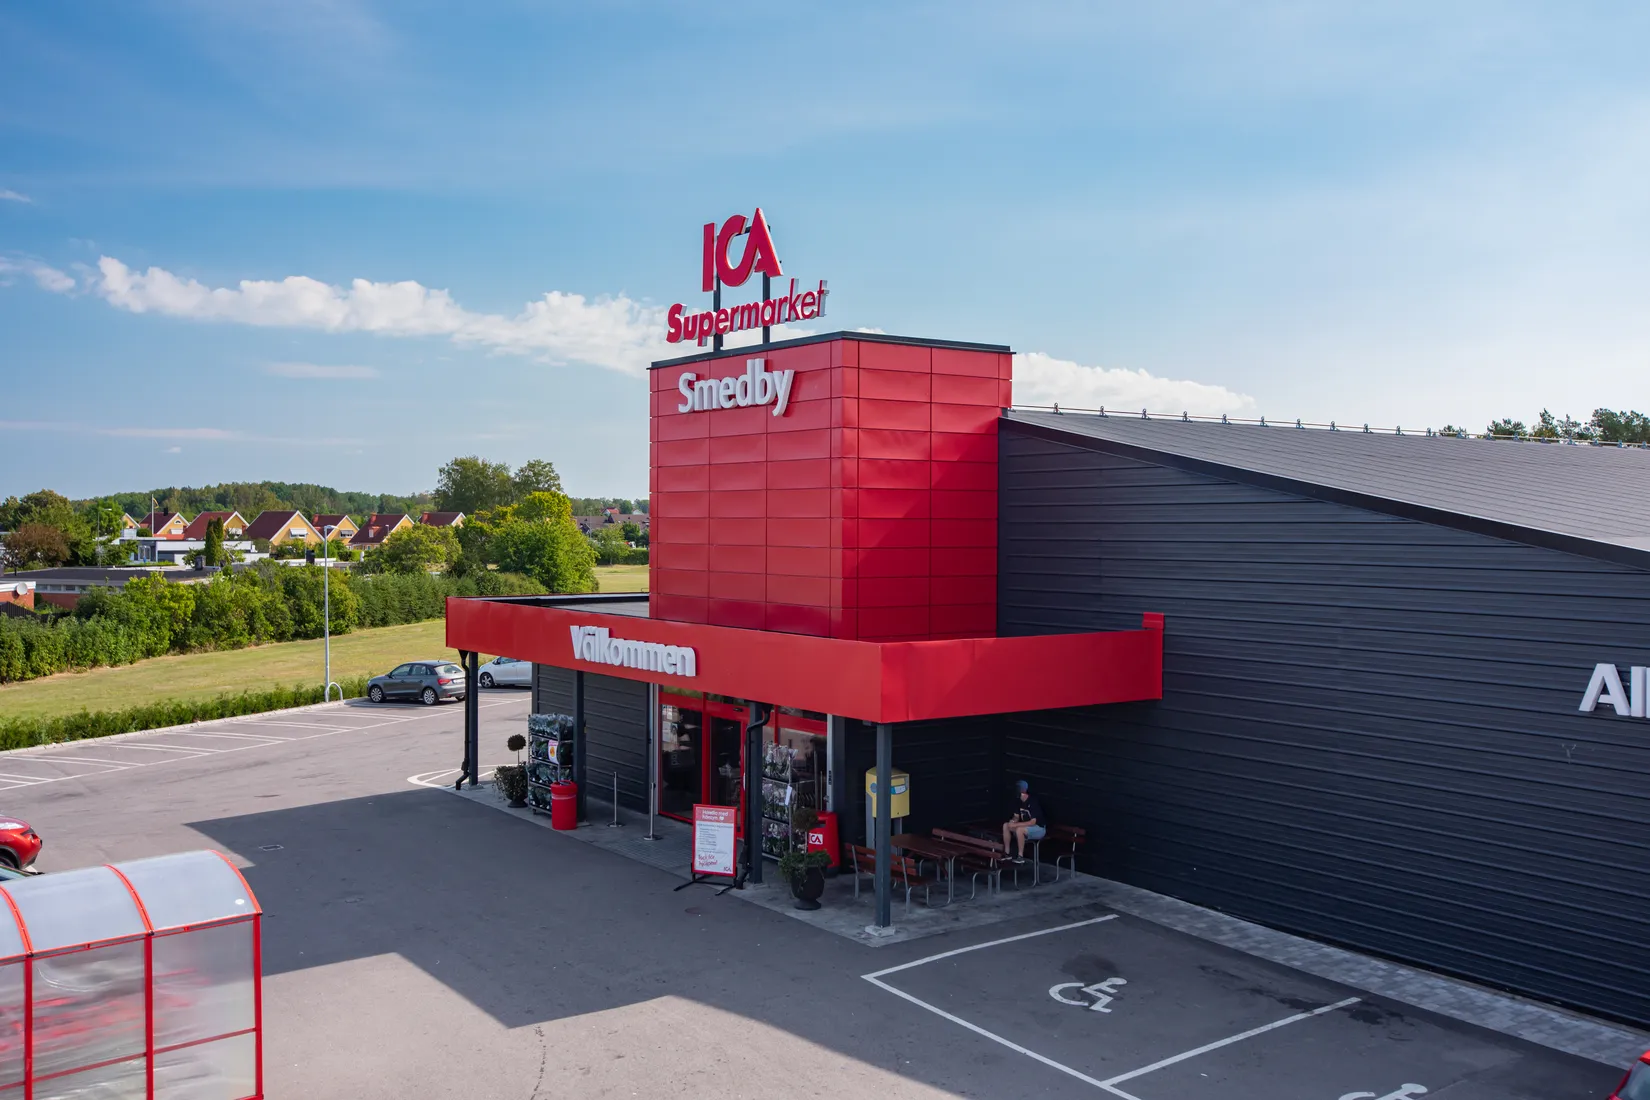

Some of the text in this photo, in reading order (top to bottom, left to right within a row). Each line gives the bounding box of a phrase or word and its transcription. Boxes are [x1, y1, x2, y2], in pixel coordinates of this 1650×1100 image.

[702, 208, 783, 292] ICA
[666, 278, 829, 346] Supermarket
[678, 358, 794, 416] Smedby
[569, 625, 696, 677] Välkommen
[1579, 663, 1650, 718] Al
